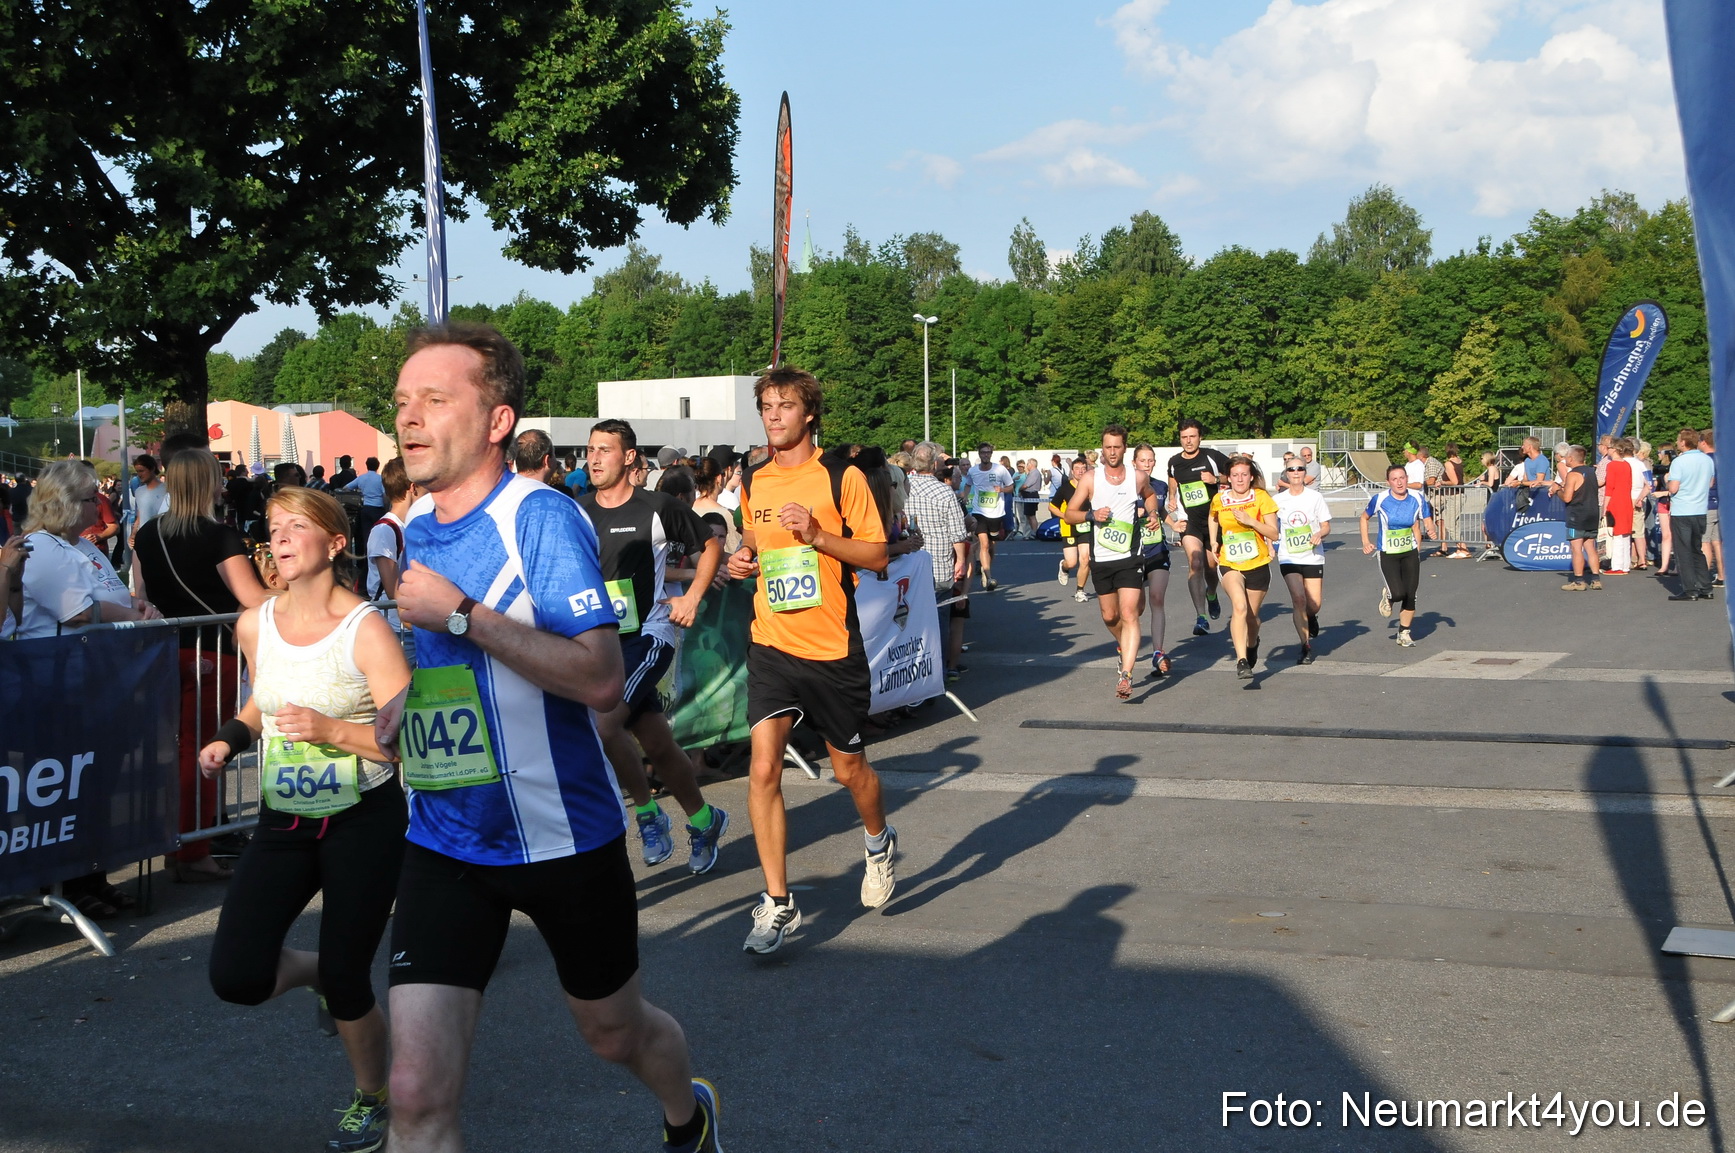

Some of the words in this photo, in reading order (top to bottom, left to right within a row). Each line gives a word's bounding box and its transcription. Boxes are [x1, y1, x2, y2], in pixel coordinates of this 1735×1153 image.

[1632, 354, 1645, 374] Druck
[1600, 340, 1645, 417] Frischmann
[980, 496, 994, 505] 870
[1185, 489, 1204, 501] 968
[755, 508, 772, 524] PE
[1103, 527, 1127, 545] 880
[1287, 533, 1312, 547] 1024
[1387, 536, 1411, 547] 1035
[1229, 541, 1253, 556] 816
[1527, 542, 1570, 555] Fisch
[767, 574, 817, 603] 5029
[887, 636, 924, 664] Neumarkter
[879, 654, 932, 694] Lammsbräu
[401, 708, 485, 760] 1042
[434, 761, 458, 769] Vögele
[276, 763, 342, 798] 564
